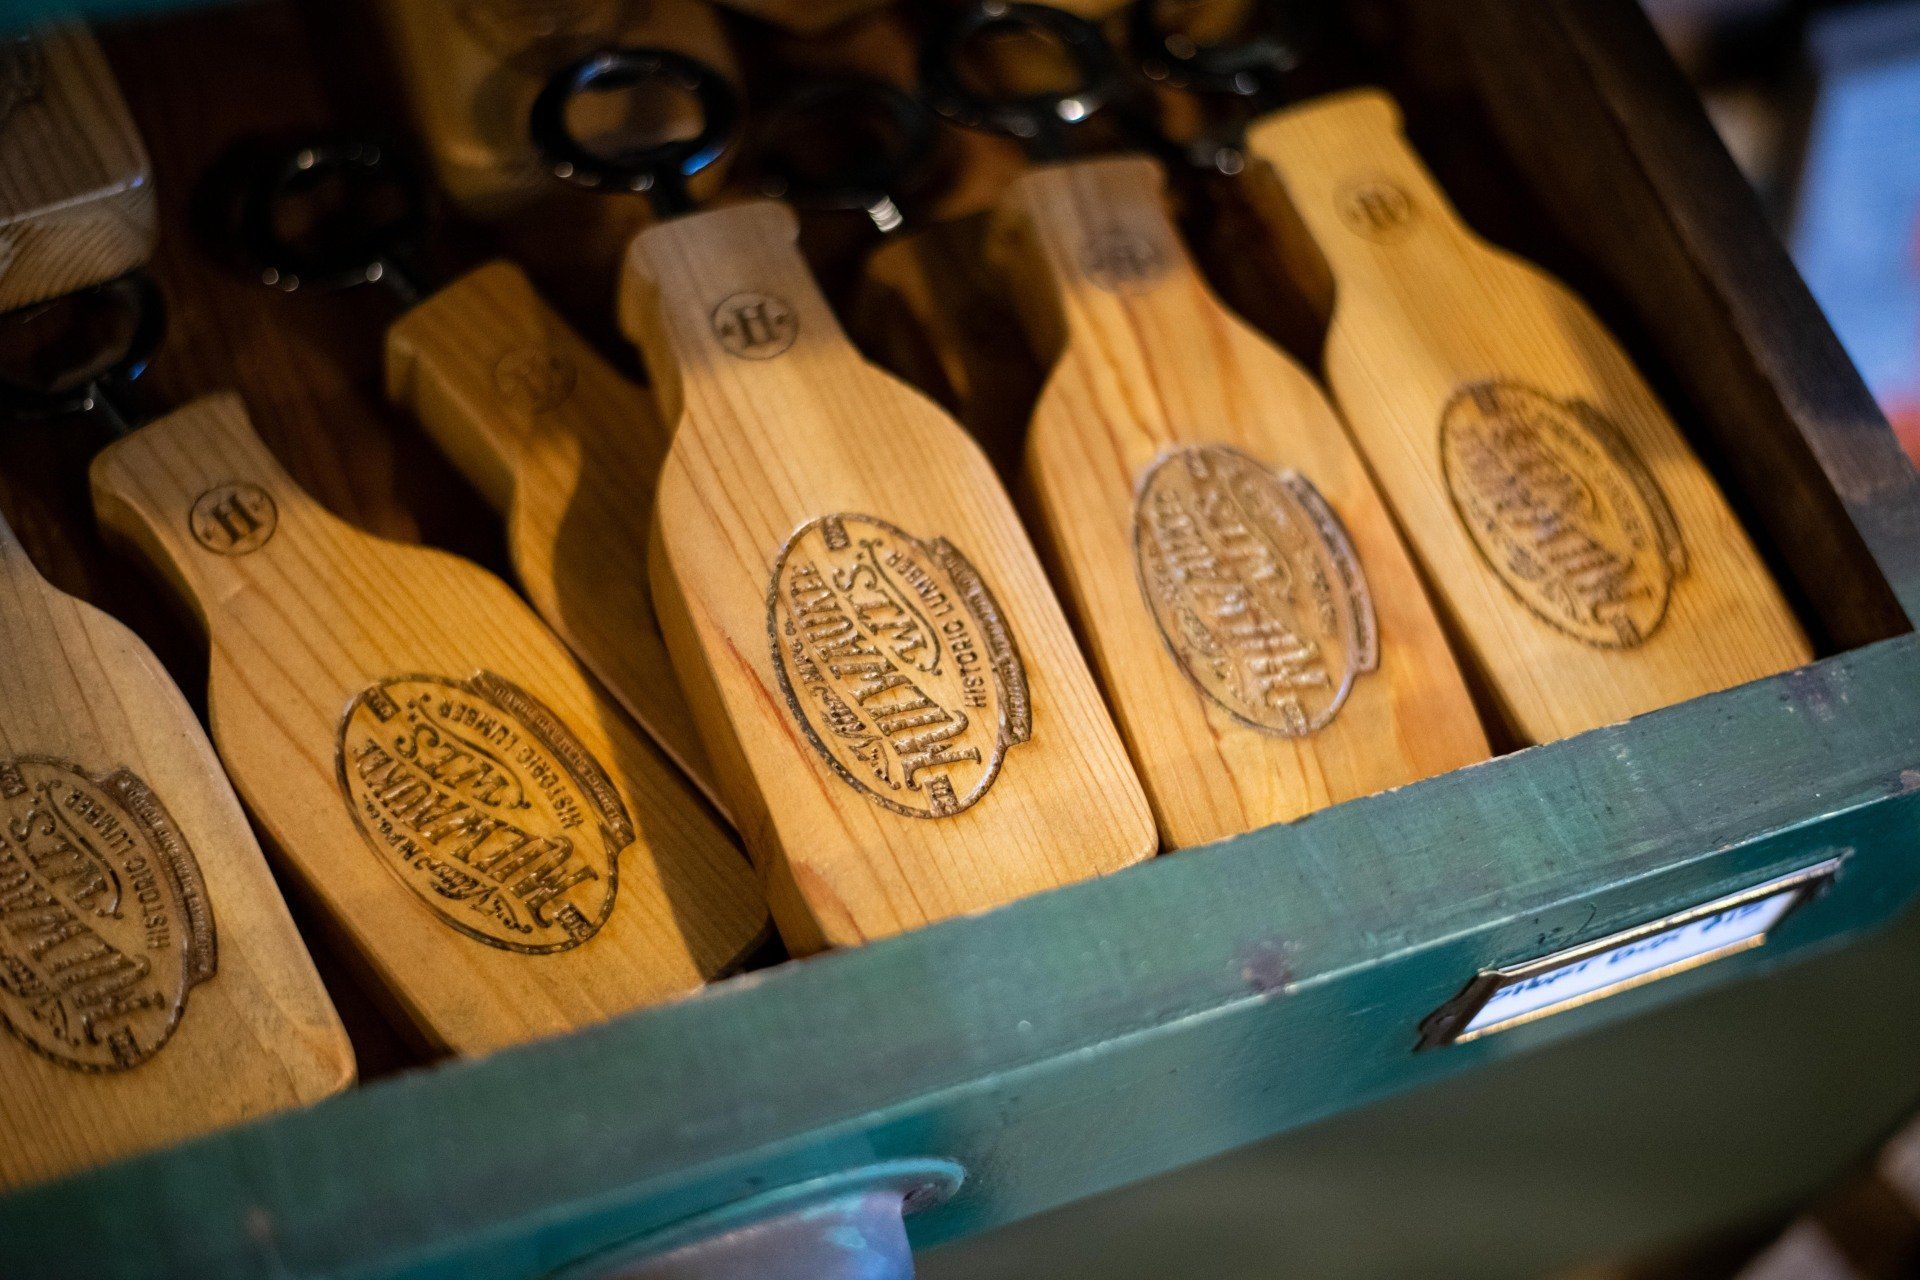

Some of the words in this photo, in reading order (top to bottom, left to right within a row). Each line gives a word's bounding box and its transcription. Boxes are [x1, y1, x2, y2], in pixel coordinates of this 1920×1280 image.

[884, 551, 953, 618] LUMBER
[787, 557, 984, 794] MILWAUKEE
[943, 617, 988, 713] HISTORIC
[435, 697, 521, 752] LUMBER
[63, 788, 136, 857] LUMBER
[348, 736, 601, 931] MILWAUKEE
[514, 745, 585, 832] HISTORIC
[124, 853, 172, 952] HISTORIC
